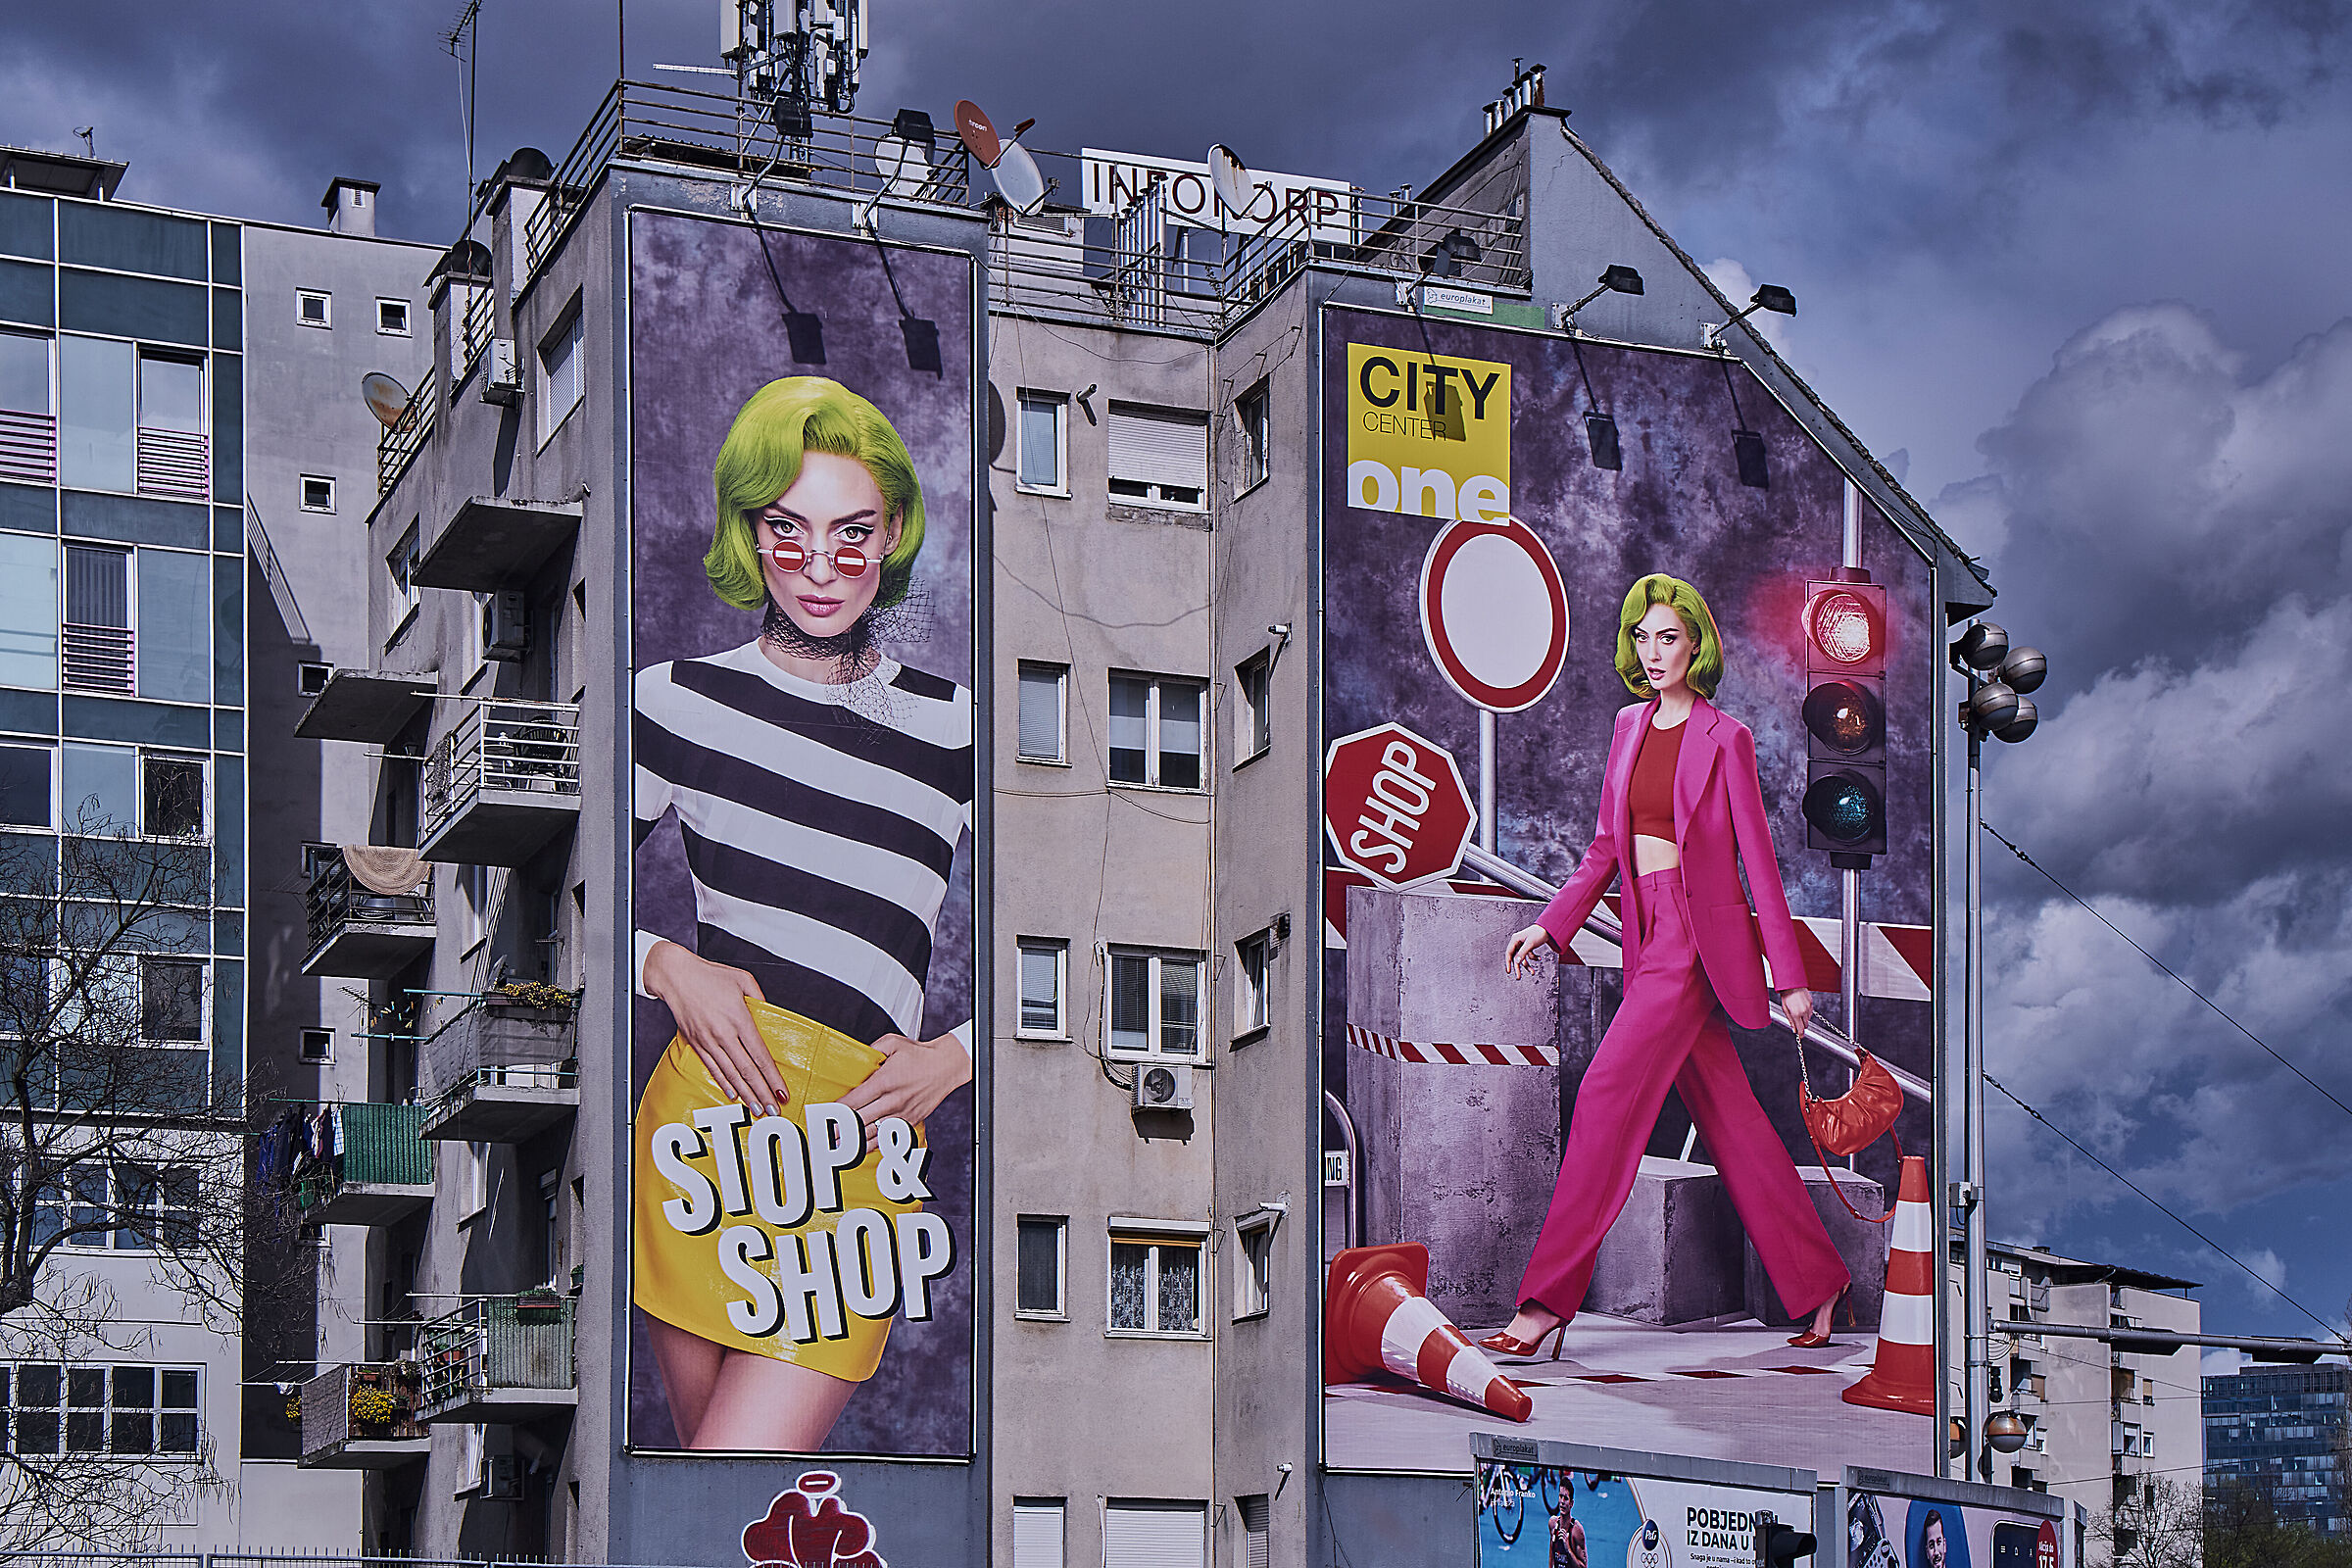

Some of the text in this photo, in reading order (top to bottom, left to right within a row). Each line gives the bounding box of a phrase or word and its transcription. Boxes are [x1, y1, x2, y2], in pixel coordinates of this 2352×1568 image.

[1441, 293, 1486, 306] europlakat
[1359, 356, 1501, 420] CITY
[1362, 411, 1446, 442] CENTER
[1348, 460, 1510, 526] one
[1349, 740, 1437, 874] SHOP
[651, 1102, 940, 1236] STOP &
[717, 1207, 957, 1346] SHOP
[1687, 1529, 1699, 1546] IZ
[1701, 1531, 1738, 1550] DANA
[1740, 1535, 1749, 1551] U
